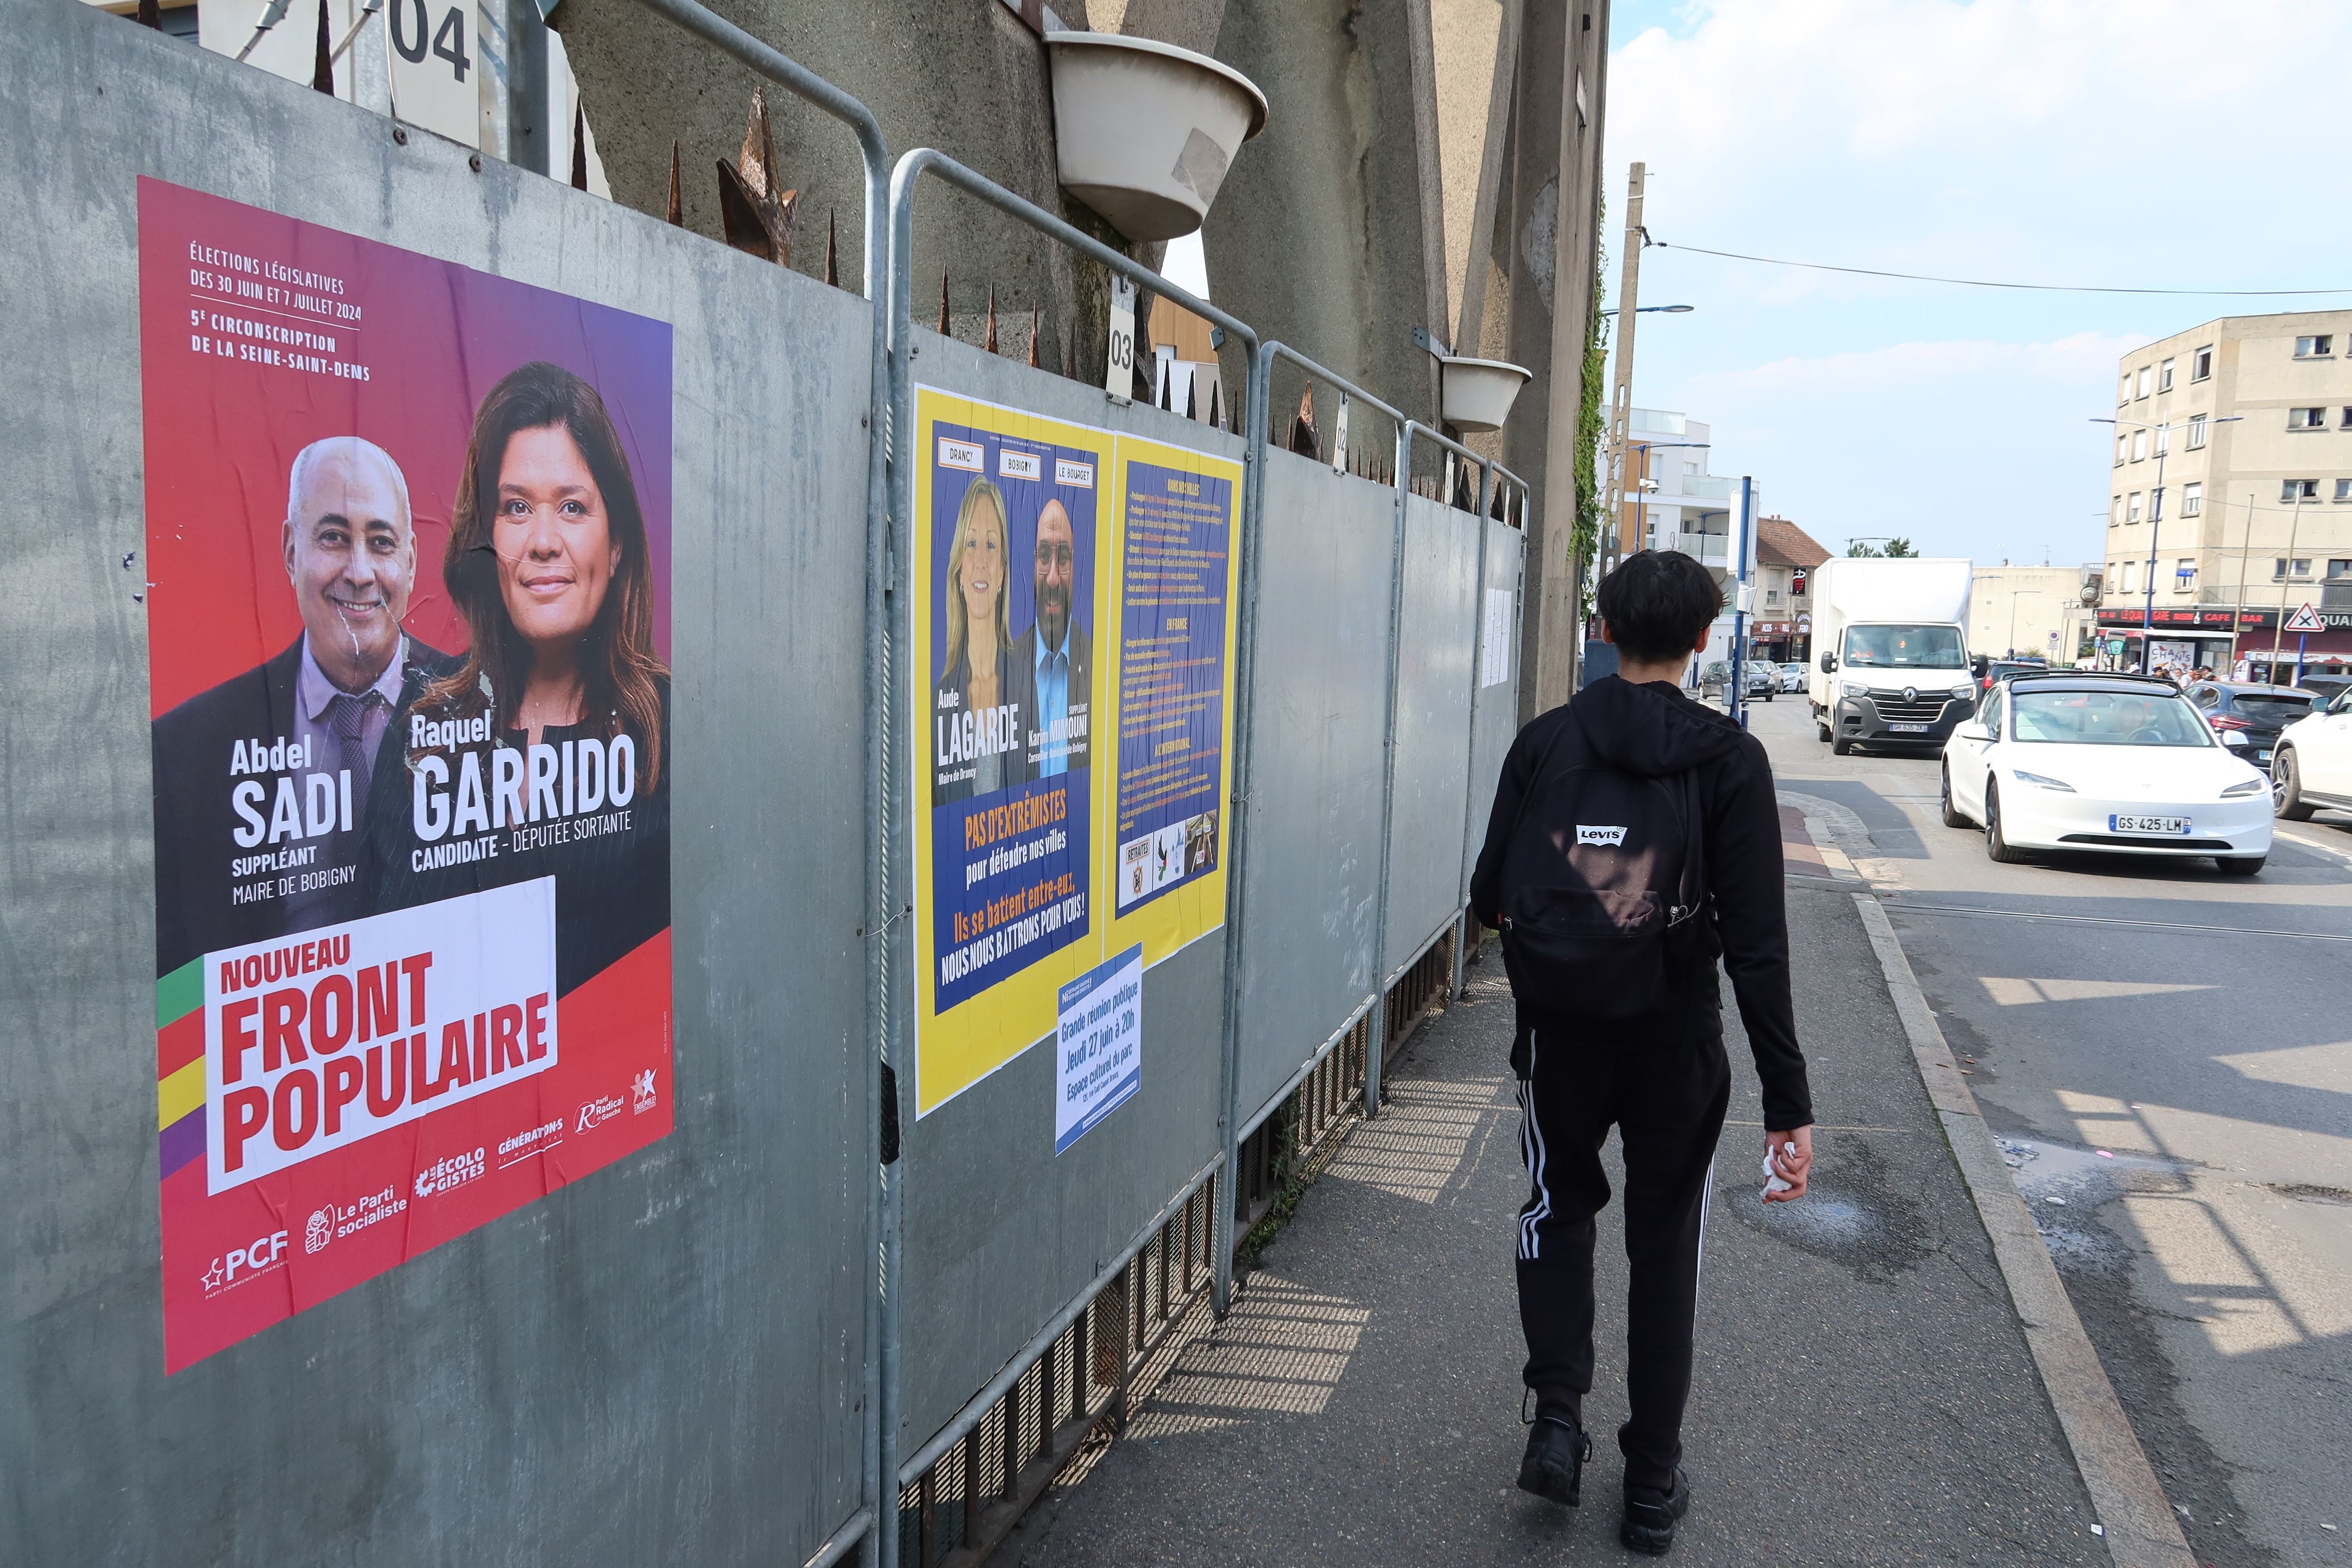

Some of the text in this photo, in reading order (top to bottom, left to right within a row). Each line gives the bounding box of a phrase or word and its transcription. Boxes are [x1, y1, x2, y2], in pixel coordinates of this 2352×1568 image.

[390, 0, 470, 83] 04
[190, 240, 344, 295] ÉLECTIONS LÉGISLATIVES
[191, 269, 362, 321] DES 30 JUIN ET 7 JUILLET 2024
[191, 334, 210, 354] DE
[216, 339, 234, 358] LA
[211, 313, 336, 353] CIRCONSCRIPTION
[1111, 330, 1131, 370] 03
[950, 447, 973, 463] DRANCY
[1337, 426, 1345, 452] 02
[1058, 467, 1089, 482] LE BOURGET
[1168, 478, 1200, 496] DANS VILLES
[1446, 474, 1452, 491] 01
[1167, 617, 1187, 631] EN FRANCE
[938, 688, 959, 709] Aude
[412, 709, 491, 754] Raquel
[938, 703, 1019, 767] LAGARDE
[1029, 728, 1048, 748] Karim
[230, 733, 312, 776] Abdel
[953, 770, 959, 782] de
[960, 767, 977, 781] Drancy
[413, 734, 635, 842] GARRIDO
[232, 769, 353, 848] SADI
[965, 810, 986, 851] PAS
[988, 788, 1066, 844] D'EXTRÊMISTES
[2119, 818, 2181, 831] GS-425-LM
[232, 845, 317, 877] SUPPLÉANT
[412, 809, 632, 873] CANDIDATE DÉPUTÉE SORTANTE
[966, 827, 1066, 891] pour défendre nos villes
[1128, 841, 1148, 862] RETRAITES
[232, 864, 357, 906] MAIRE DE BOBIGNY
[954, 871, 1075, 944] Ils se battent entre-eux,
[221, 933, 350, 994] NOUVEAU
[941, 945, 969, 987] NOUS
[970, 933, 995, 972] NOUS
[997, 912, 1040, 960] BATTRONS
[1041, 904, 1062, 936] POUR
[1062, 989, 1068, 1004] Ni
[1062, 981, 1138, 1043] Grande réunion publique
[222, 950, 433, 1086] FRONT
[1065, 1008, 1135, 1075] Jeudi 27 juin à 20h
[223, 991, 549, 1174] POPULAIRE
[1067, 1042, 1132, 1102] Espace culturel du parc
[596, 1095, 609, 1106] Parti
[596, 1095, 624, 1115] Radical
[602, 1108, 621, 1120] Gauche
[437, 1147, 485, 1179] ÉCOLO
[437, 1161, 485, 1192] GISTES
[337, 1184, 394, 1222] Le Parti
[337, 1198, 408, 1238] socialiste
[225, 1230, 288, 1282] PCF
[223, 1273, 262, 1292] COMMUNISTE
